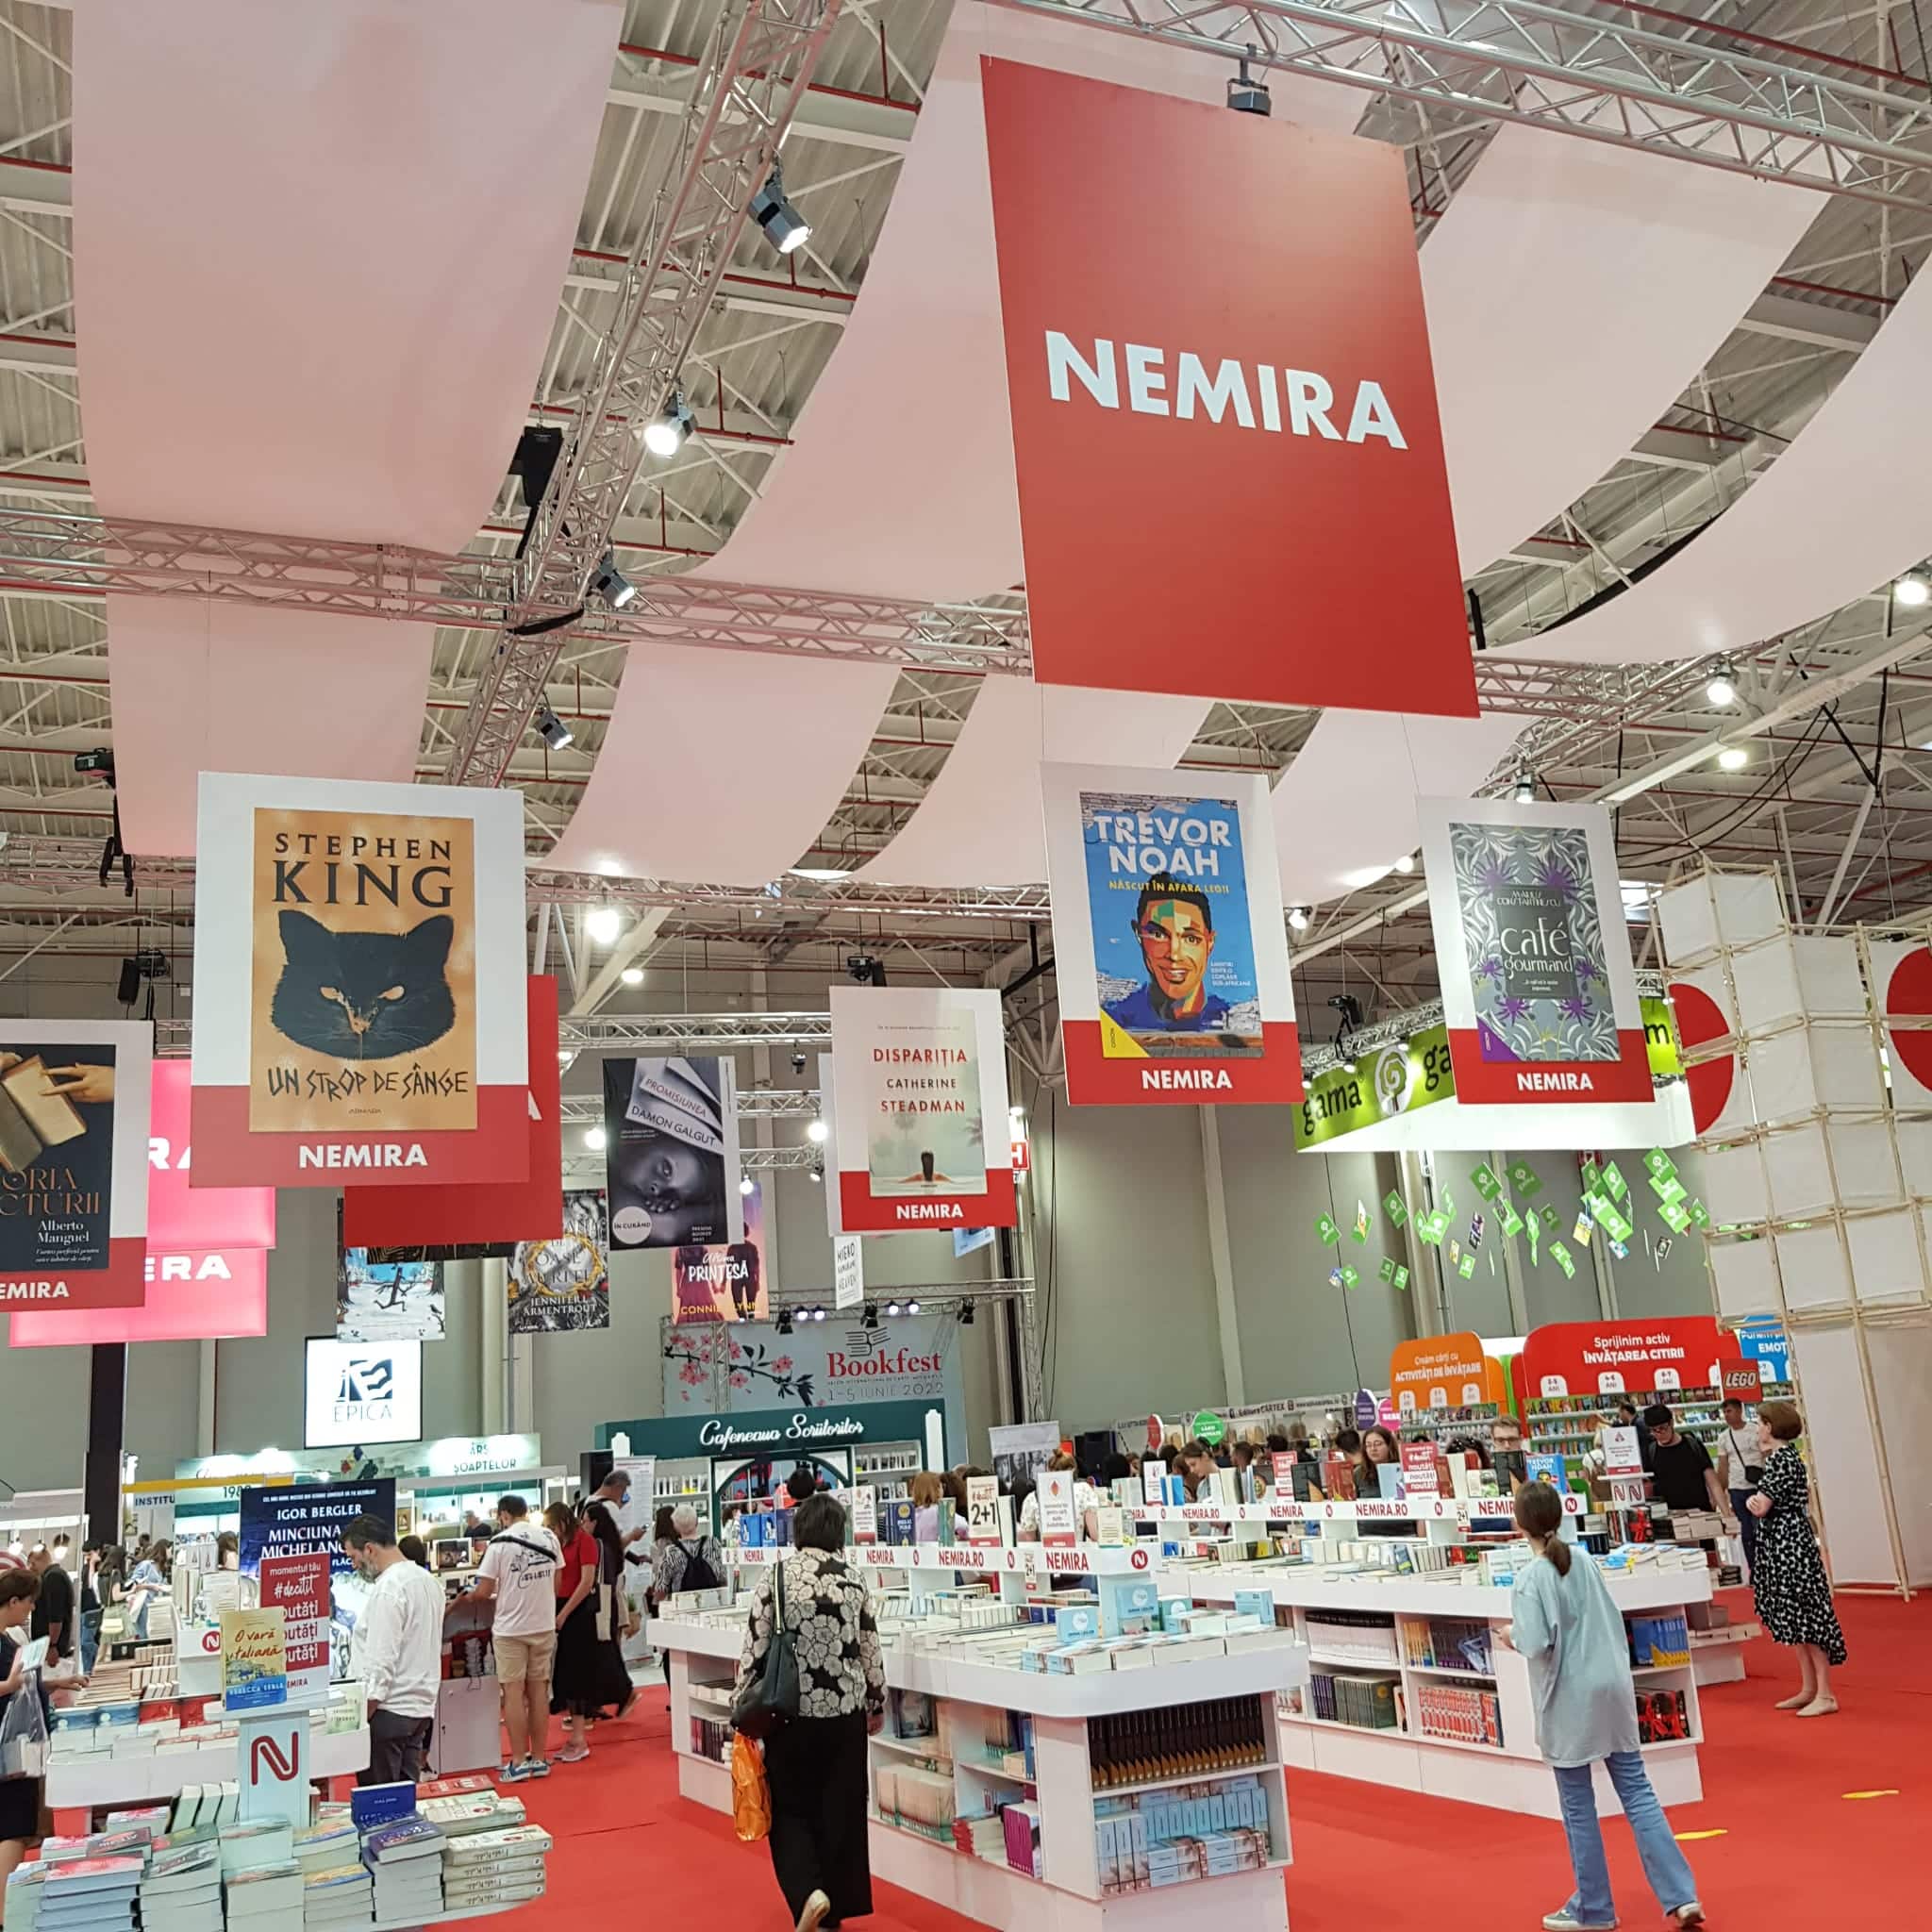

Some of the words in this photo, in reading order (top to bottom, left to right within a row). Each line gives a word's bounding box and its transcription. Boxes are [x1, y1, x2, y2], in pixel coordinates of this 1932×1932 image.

[1045, 329, 1408, 450] NEMIRA
[1094, 815, 1233, 847] TREVOR
[275, 833, 451, 860] STEPHEN
[1108, 846, 1220, 876] NOAH
[272, 859, 454, 908] KING
[1168, 881, 1201, 893] AFARA
[1500, 917, 1570, 957] café
[1504, 955, 1574, 980] gourmand
[874, 1047, 967, 1067] DISPARIȚIA
[1423, 1043, 1452, 1092] ga
[268, 1067, 299, 1096] UN
[306, 1067, 367, 1102] STROP
[374, 1070, 400, 1094] DE
[401, 1062, 469, 1099] SÂNGE
[887, 1078, 958, 1089] CATHERINE
[1141, 1070, 1233, 1090] NEMIRA
[1516, 1073, 1594, 1091] NEMIRA
[644, 1078, 707, 1118] PROMISIUNEA
[880, 1100, 966, 1113] STEADMAN
[1302, 1081, 1362, 1137] gama
[630, 1105, 674, 1130] DAMON
[674, 1119, 717, 1147] GALGUT
[298, 1143, 428, 1169] NEMIRA
[896, 1204, 964, 1220] NEMIRA
[38, 1220, 84, 1231] Alberto
[38, 1230, 89, 1245] Manguel
[524, 1304, 596, 1317] ARMENTROUT
[680, 1304, 719, 1315] CONNI
[1593, 1334, 1643, 1349] Sprijinim
[1645, 1332, 1671, 1344] activ
[826, 1347, 942, 1378] Bookfest
[1583, 1349, 1649, 1366] ÎNVĂȚAREA
[1650, 1347, 1685, 1360] CITIRII
[903, 1382, 943, 1397] 2022
[1724, 1372, 1757, 1389] LEGO
[333, 1404, 392, 1423] EPICA
[700, 1420, 781, 1451] Cafeneaua
[786, 1413, 864, 1439] Scriitorilor
[135, 1494, 175, 1507] INSTITU
[1357, 1503, 1407, 1517] NEMIRA.RO
[276, 1508, 308, 1521] IGOR
[311, 1504, 362, 1518] BERGLER
[971, 1502, 996, 1525] 2+1
[1183, 1508, 1220, 1520] NEMIRA.RO
[1270, 1506, 1304, 1518] NEMIRA
[268, 1524, 341, 1543] MINCIUNA
[270, 1565, 308, 1576] momentul
[308, 1563, 321, 1572] tău
[866, 1549, 894, 1565] NEMIRA
[939, 1551, 984, 1567] NEMIRA.RO
[1045, 1552, 1089, 1571] NEMIRA
[235, 1629, 245, 1642] O
[246, 1629, 275, 1641] vară
